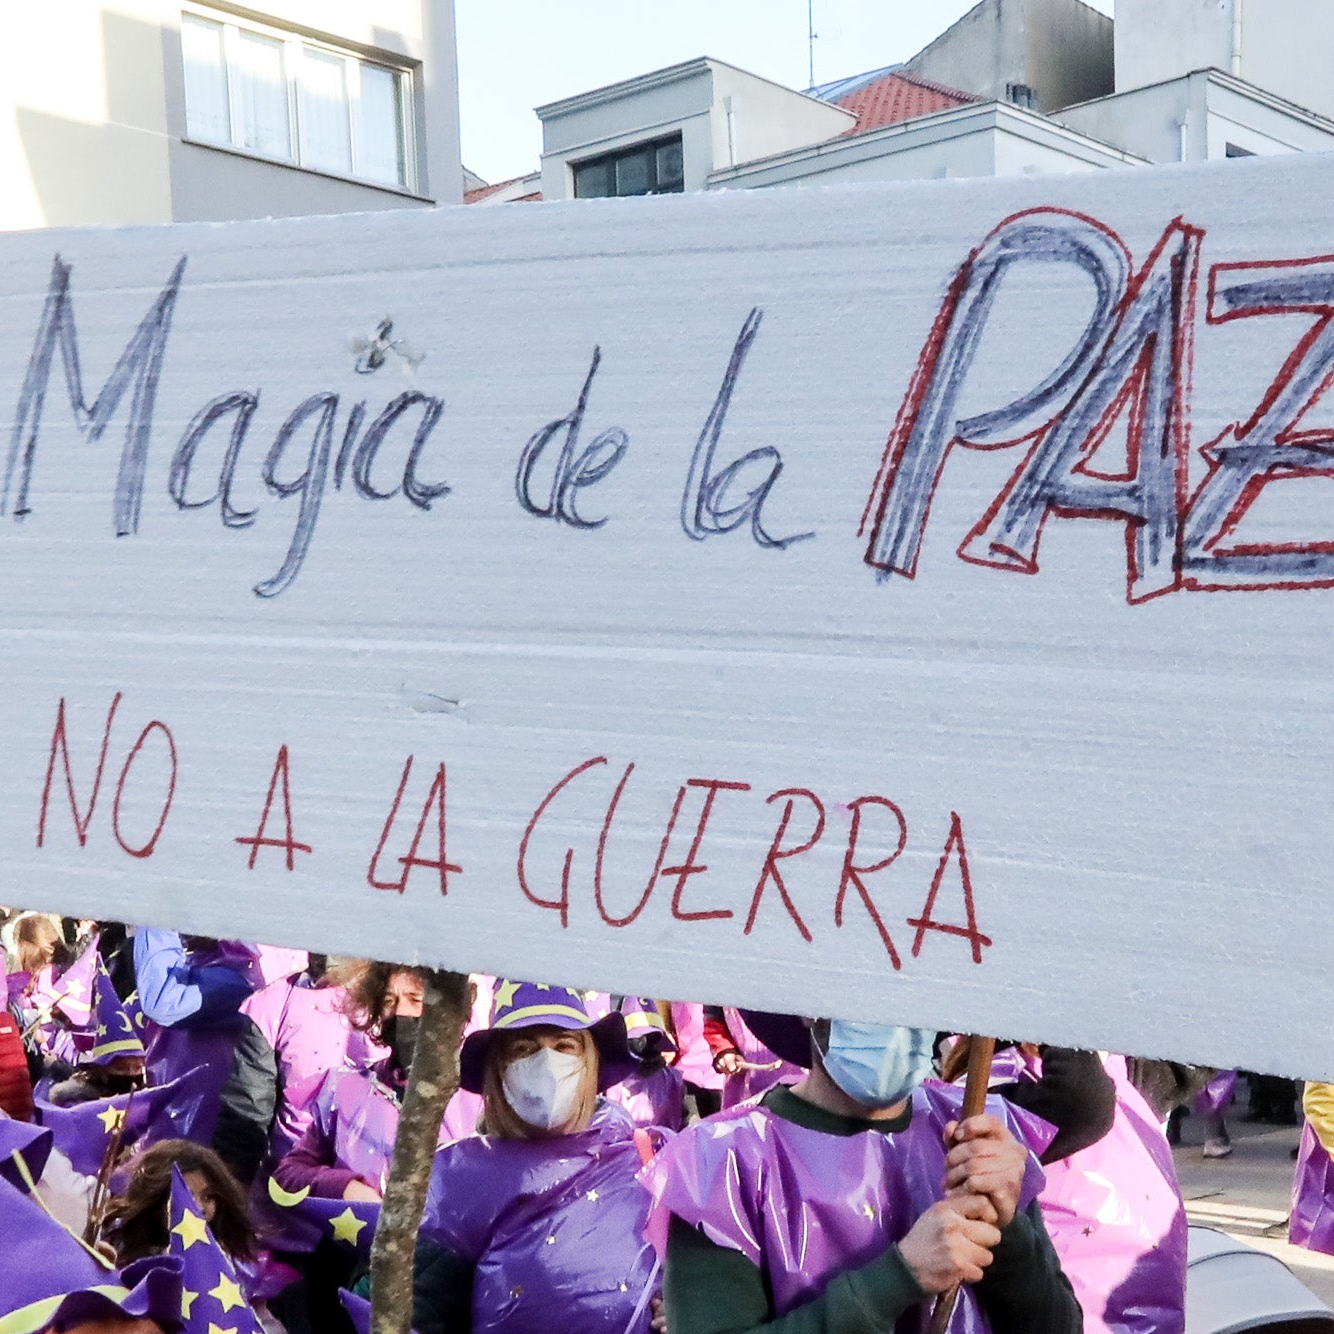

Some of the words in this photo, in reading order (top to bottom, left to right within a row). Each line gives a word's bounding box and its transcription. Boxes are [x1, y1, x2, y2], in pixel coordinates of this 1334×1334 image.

[0, 253, 451, 598] Magia
[515, 344, 628, 530] de
[681, 307, 815, 550] la
[36, 692, 178, 858] NO
[235, 744, 313, 871] A
[367, 755, 463, 896] LA
[517, 756, 992, 970] GUERRA
